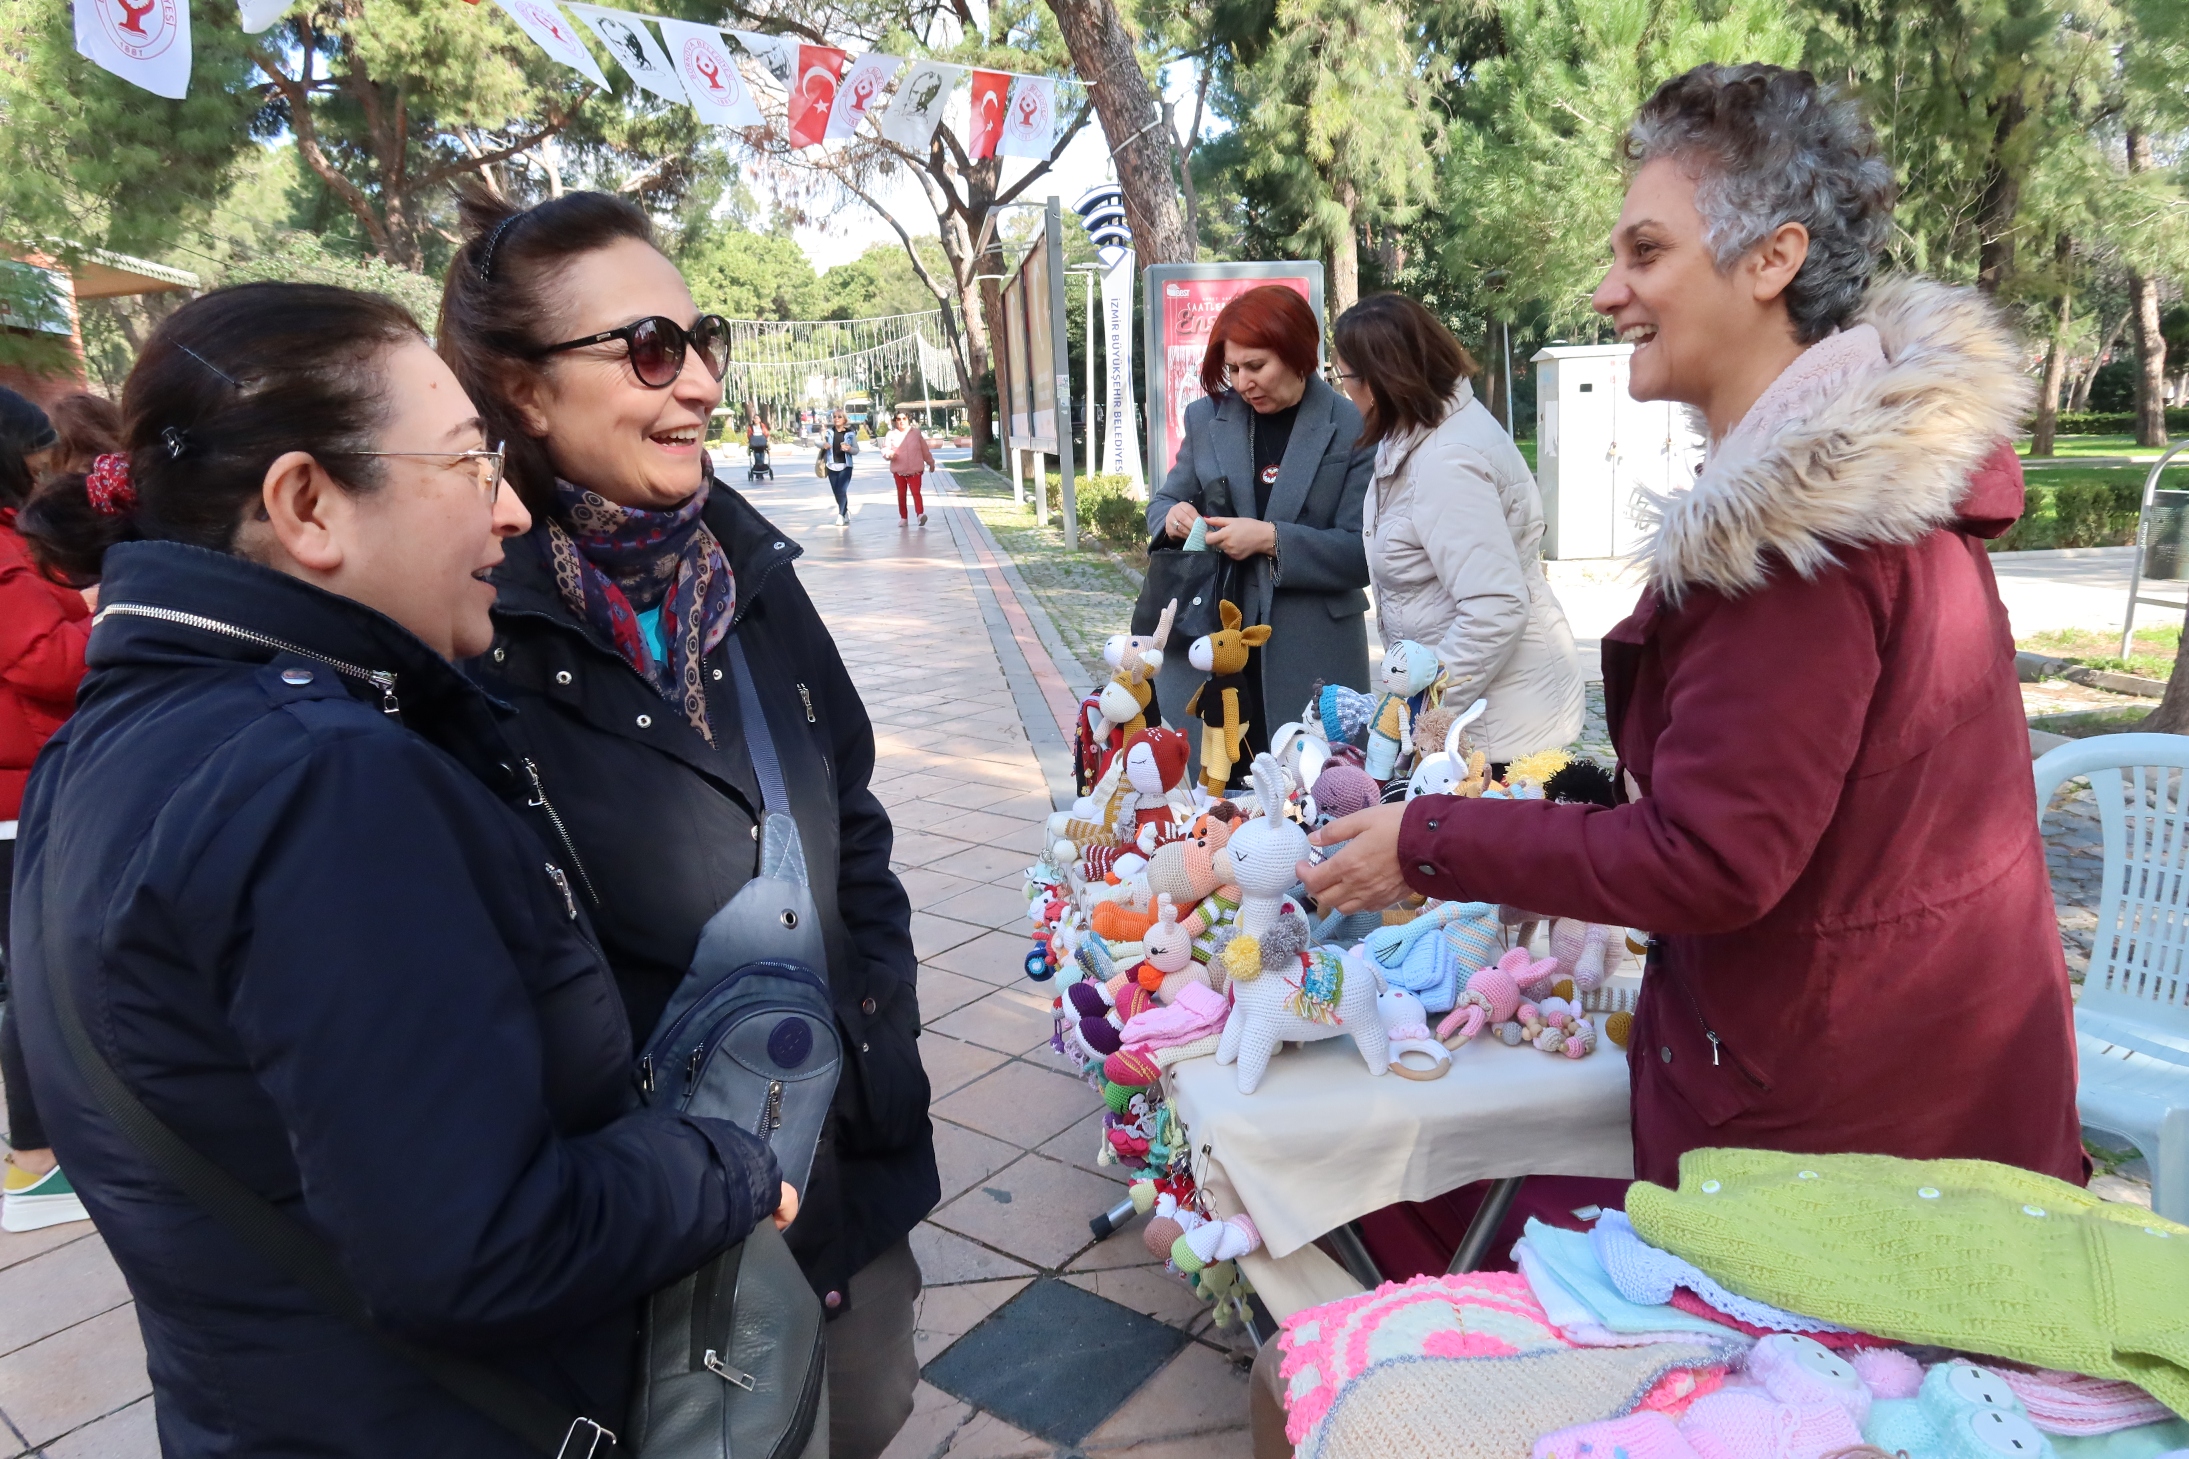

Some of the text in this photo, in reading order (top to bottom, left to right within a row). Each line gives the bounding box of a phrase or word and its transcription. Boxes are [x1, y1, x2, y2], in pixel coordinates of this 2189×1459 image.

[119, 42, 143, 57] 1881
[1110, 298, 1122, 331] İZMİR
[1187, 302, 1226, 312] SAATLER
[1110, 334, 1123, 408] BÜYÜKŞEHİR
